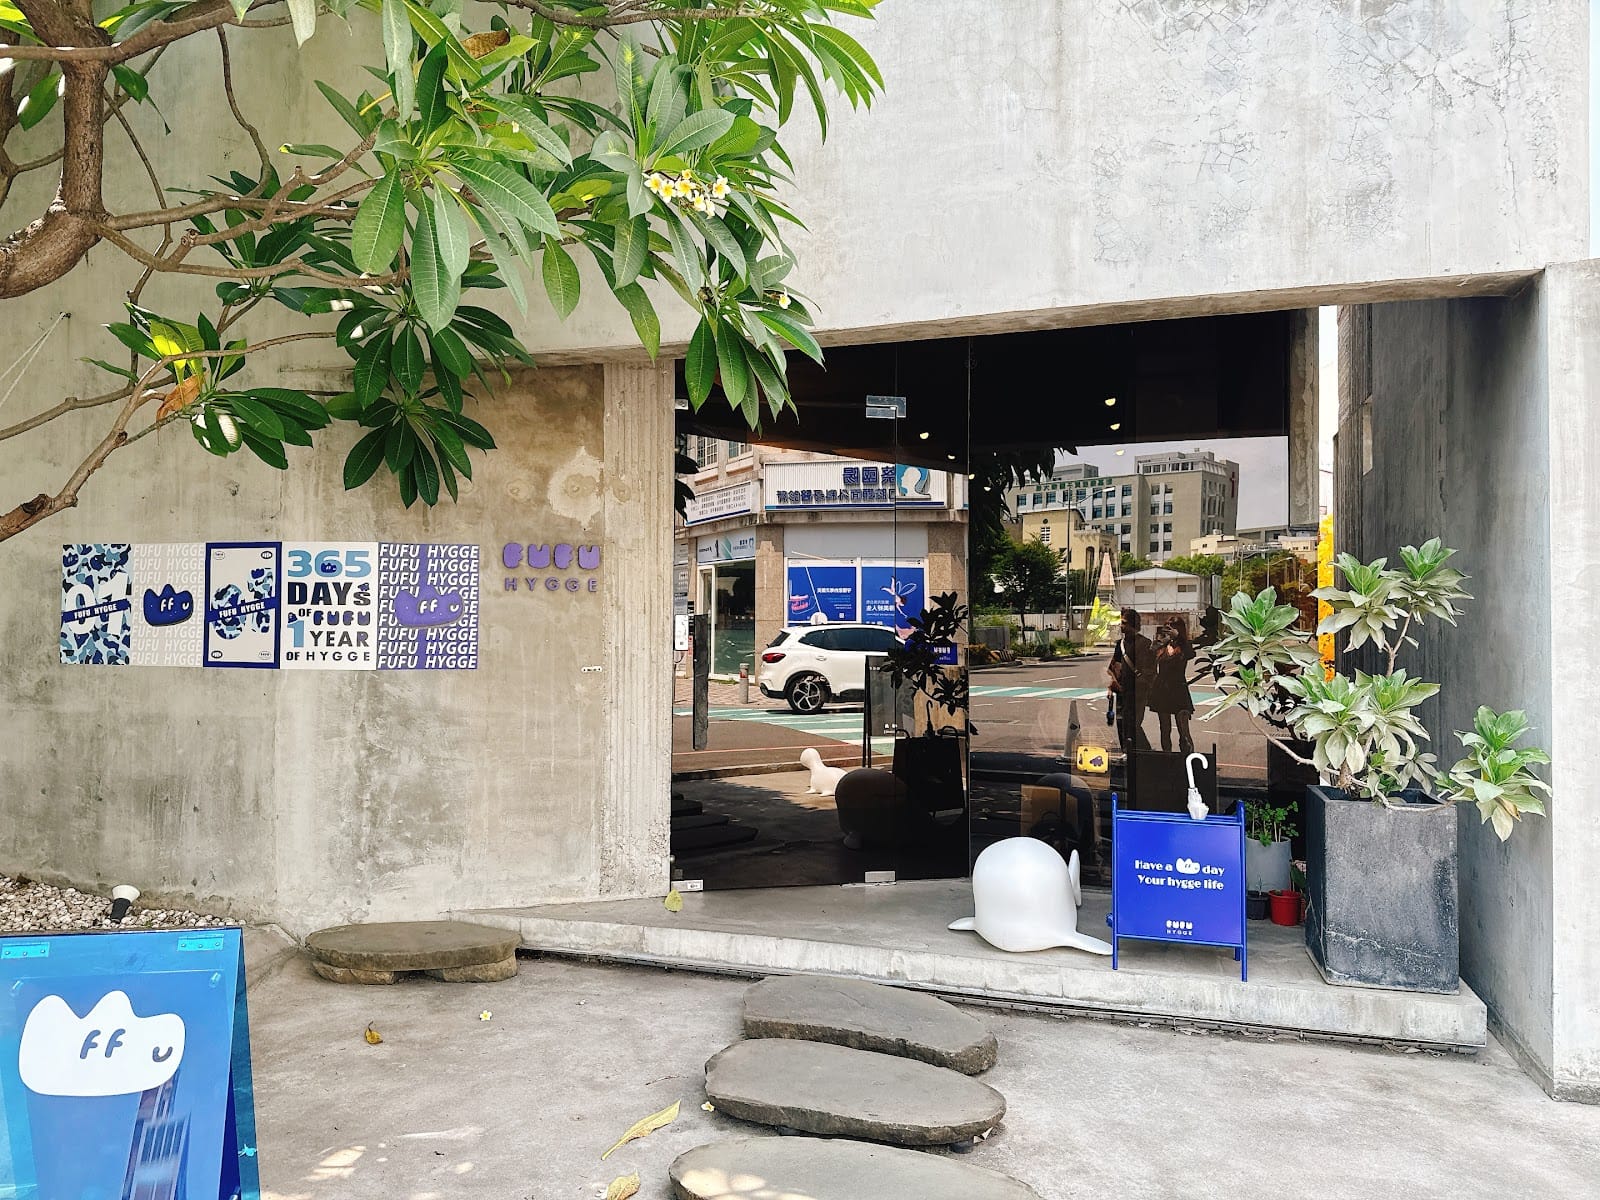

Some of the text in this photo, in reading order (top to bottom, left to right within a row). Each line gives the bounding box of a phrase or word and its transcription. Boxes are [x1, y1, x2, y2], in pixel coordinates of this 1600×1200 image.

[134, 545, 161, 557] FUFU
[167, 545, 204, 557] HYGGE
[379, 544, 479, 558] FUFU HYGGE
[503, 542, 600, 570] FUFU
[133, 558, 204, 570] FUFU HYGGE
[287, 550, 371, 577] 365
[379, 558, 479, 572] FUFU HYGGE
[133, 571, 204, 584] FUFU HYGGE
[379, 572, 479, 586] FUFU HYGGE
[505, 576, 597, 592] HYGGE
[94, 603, 118, 614] HYGGE
[219, 602, 265, 618] FUFU HYGGE
[299, 608, 370, 626] OF FUFU
[131, 626, 203, 638] FUFU HYGGE
[287, 620, 370, 648] 1 YEAR
[378, 628, 478, 641] FUFU HYGGE
[131, 639, 203, 651] FUFU HYGGE
[378, 642, 478, 655] FUFU HYGGE
[130, 652, 158, 665] FUFU
[164, 652, 203, 665] HYGGE
[286, 651, 370, 661] OF HYGGE
[377, 655, 478, 668] FUFU HYGGE
[1135, 859, 1225, 877] Have a day
[1137, 874, 1225, 891] Your hygge life
[1166, 920, 1193, 930] FUFU
